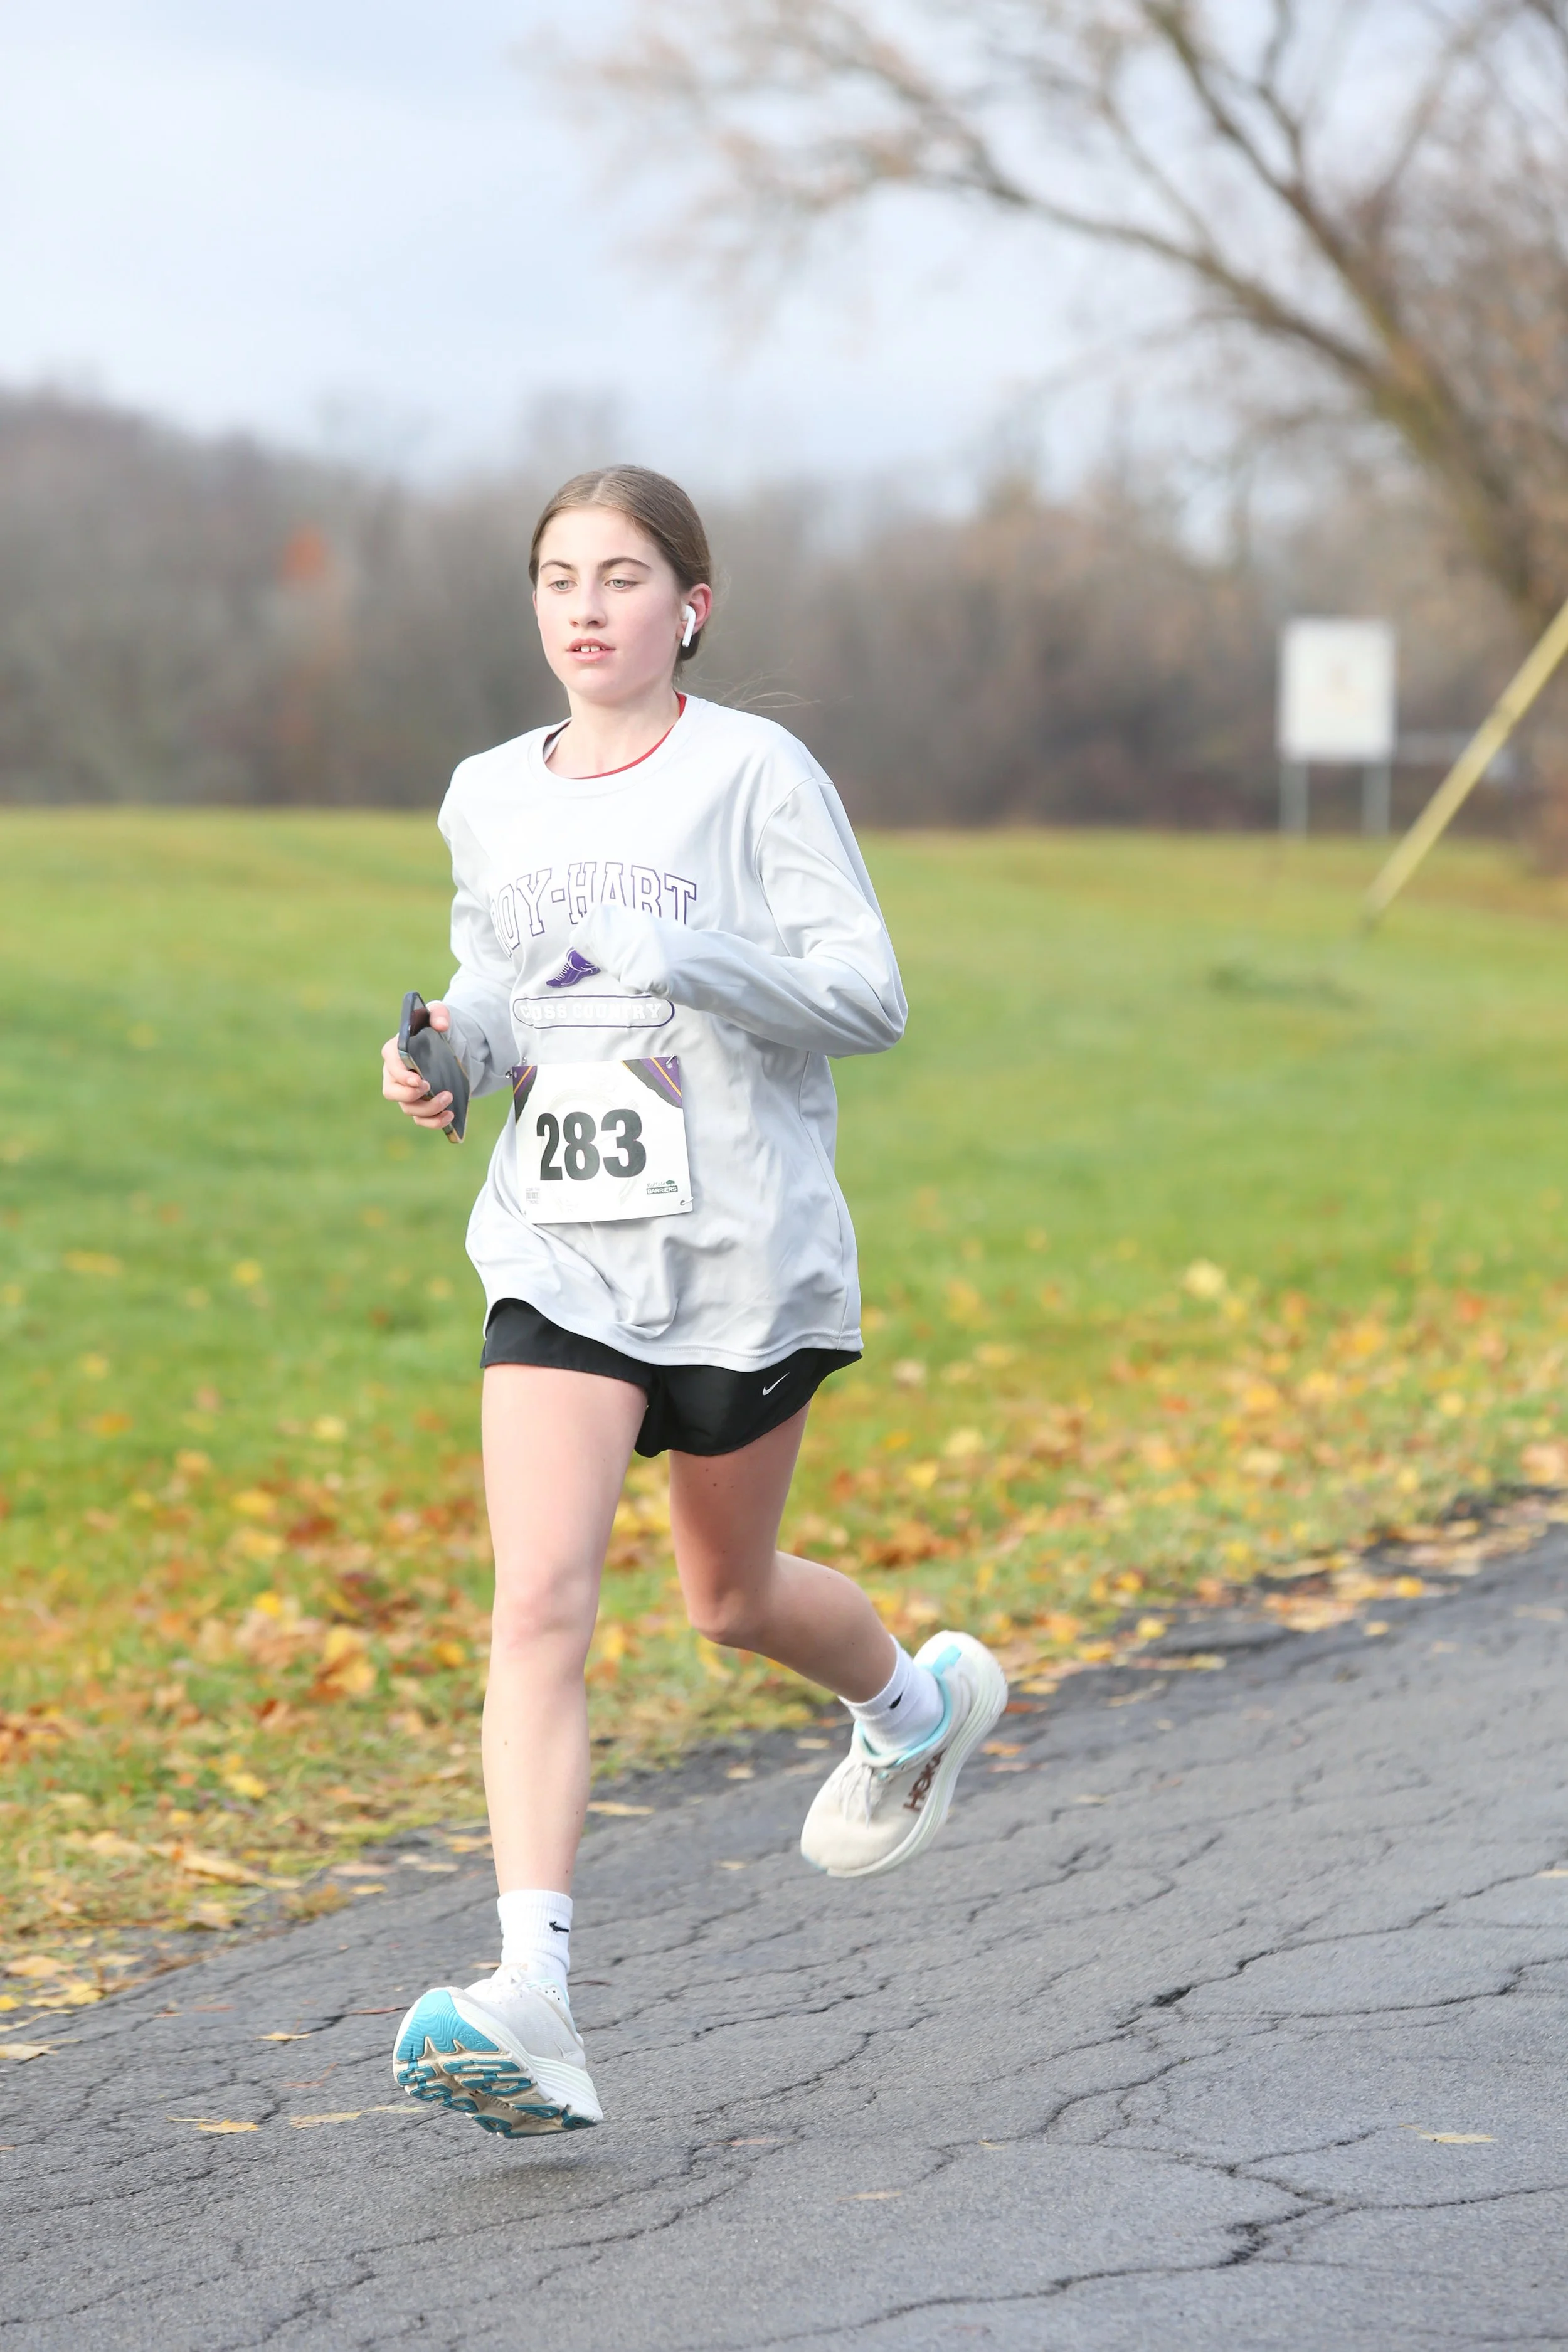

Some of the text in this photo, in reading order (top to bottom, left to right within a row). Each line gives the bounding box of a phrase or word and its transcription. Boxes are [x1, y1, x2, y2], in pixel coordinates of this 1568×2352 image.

[519, 1002, 662, 1021] COSS COUNTRY
[536, 1108, 647, 1180] 283
[647, 1186, 677, 1194] BARRIERS
